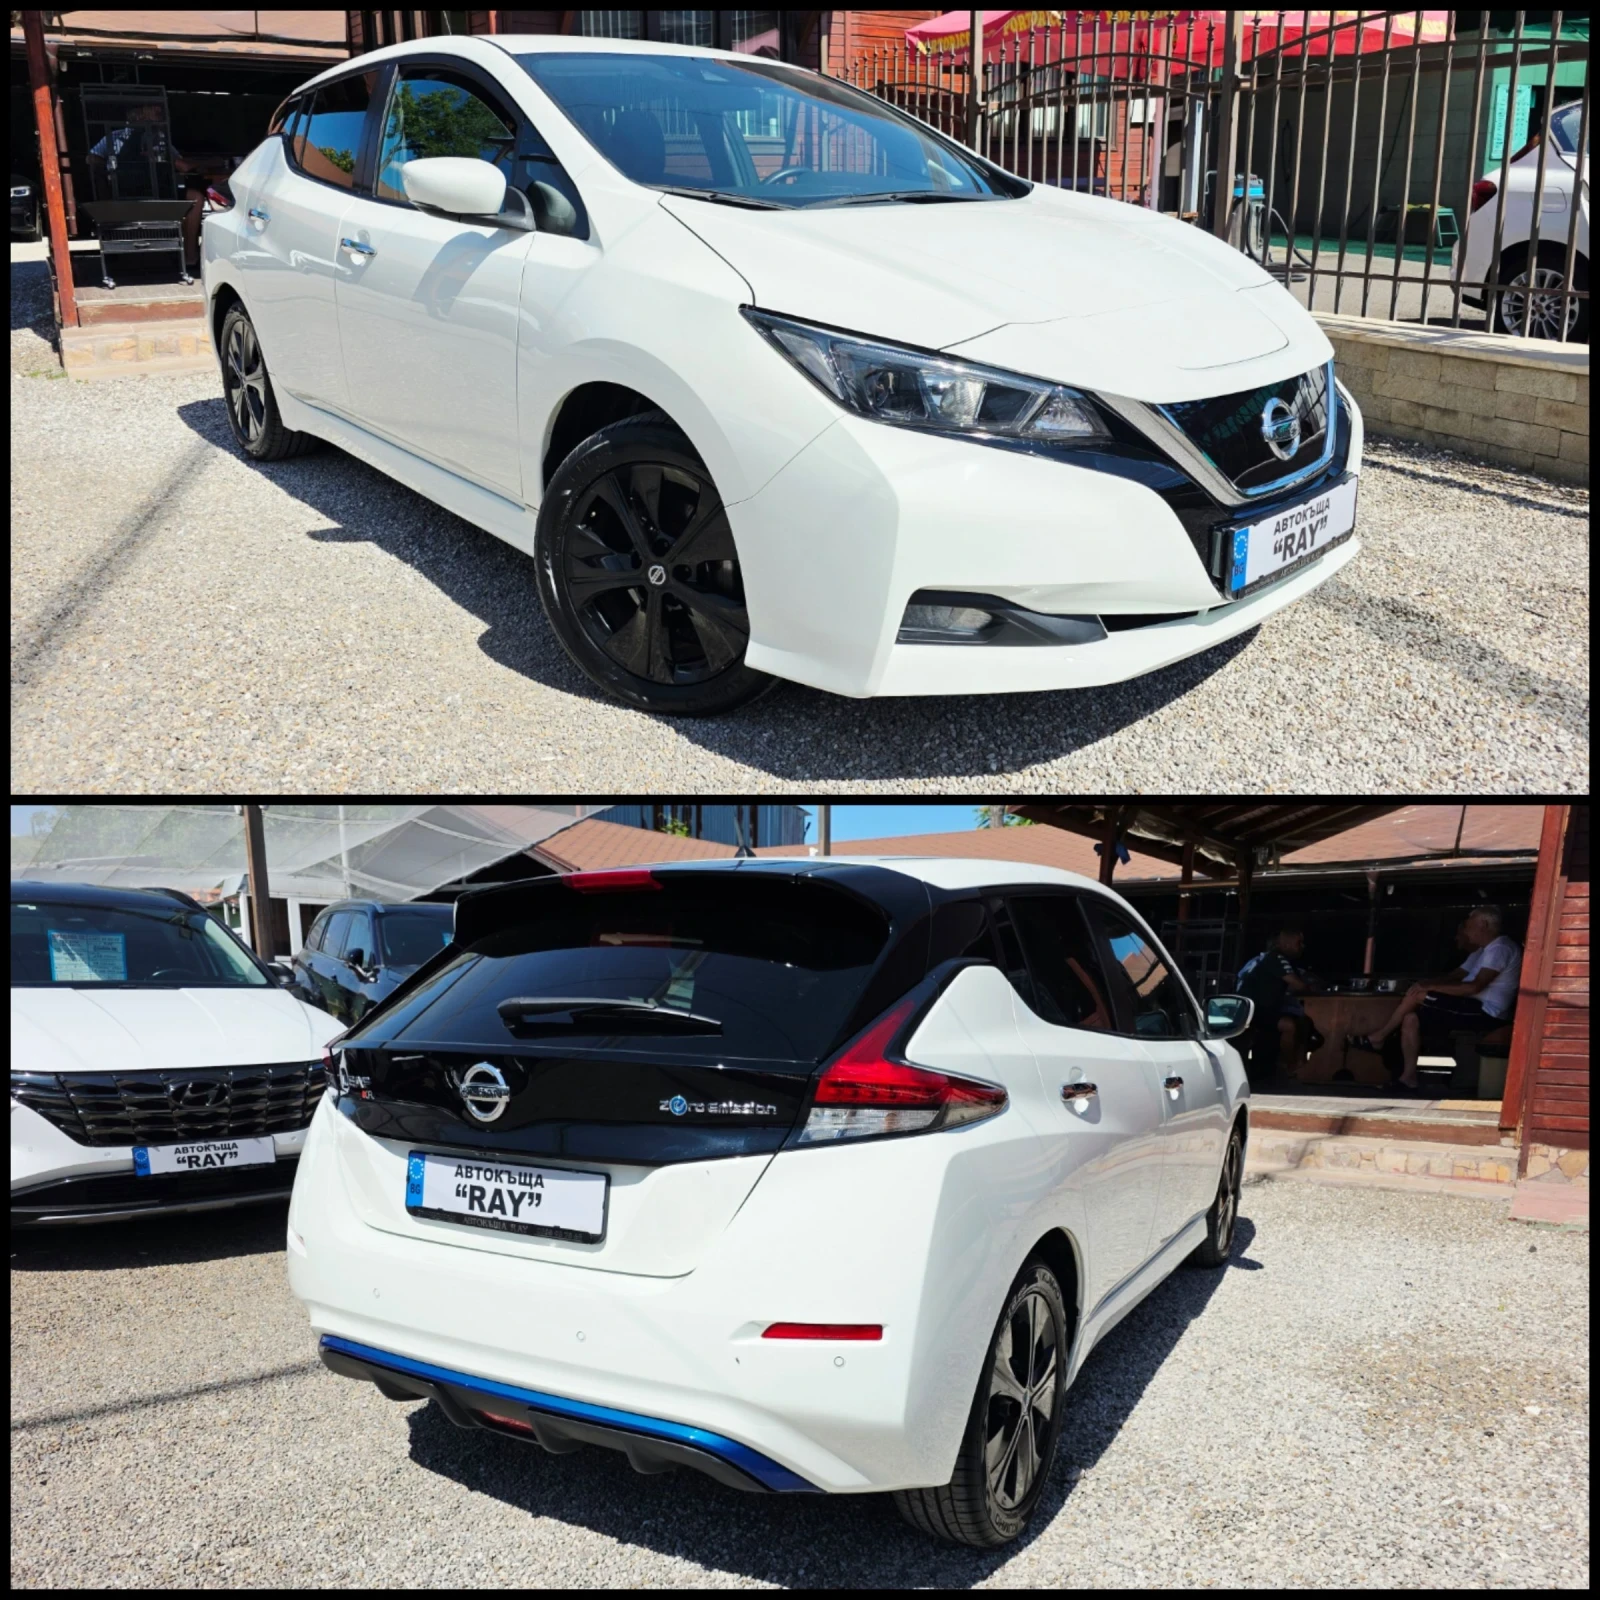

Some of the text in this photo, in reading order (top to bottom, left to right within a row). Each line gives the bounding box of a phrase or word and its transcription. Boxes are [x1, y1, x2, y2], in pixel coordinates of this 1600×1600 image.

[1273, 498, 1331, 536] АВТОКЪЩА
[174, 1142, 239, 1155] АВТОКЪЩА
[454, 1164, 545, 1189] АВТОКЪЩА
[410, 1183, 421, 1195] BG
